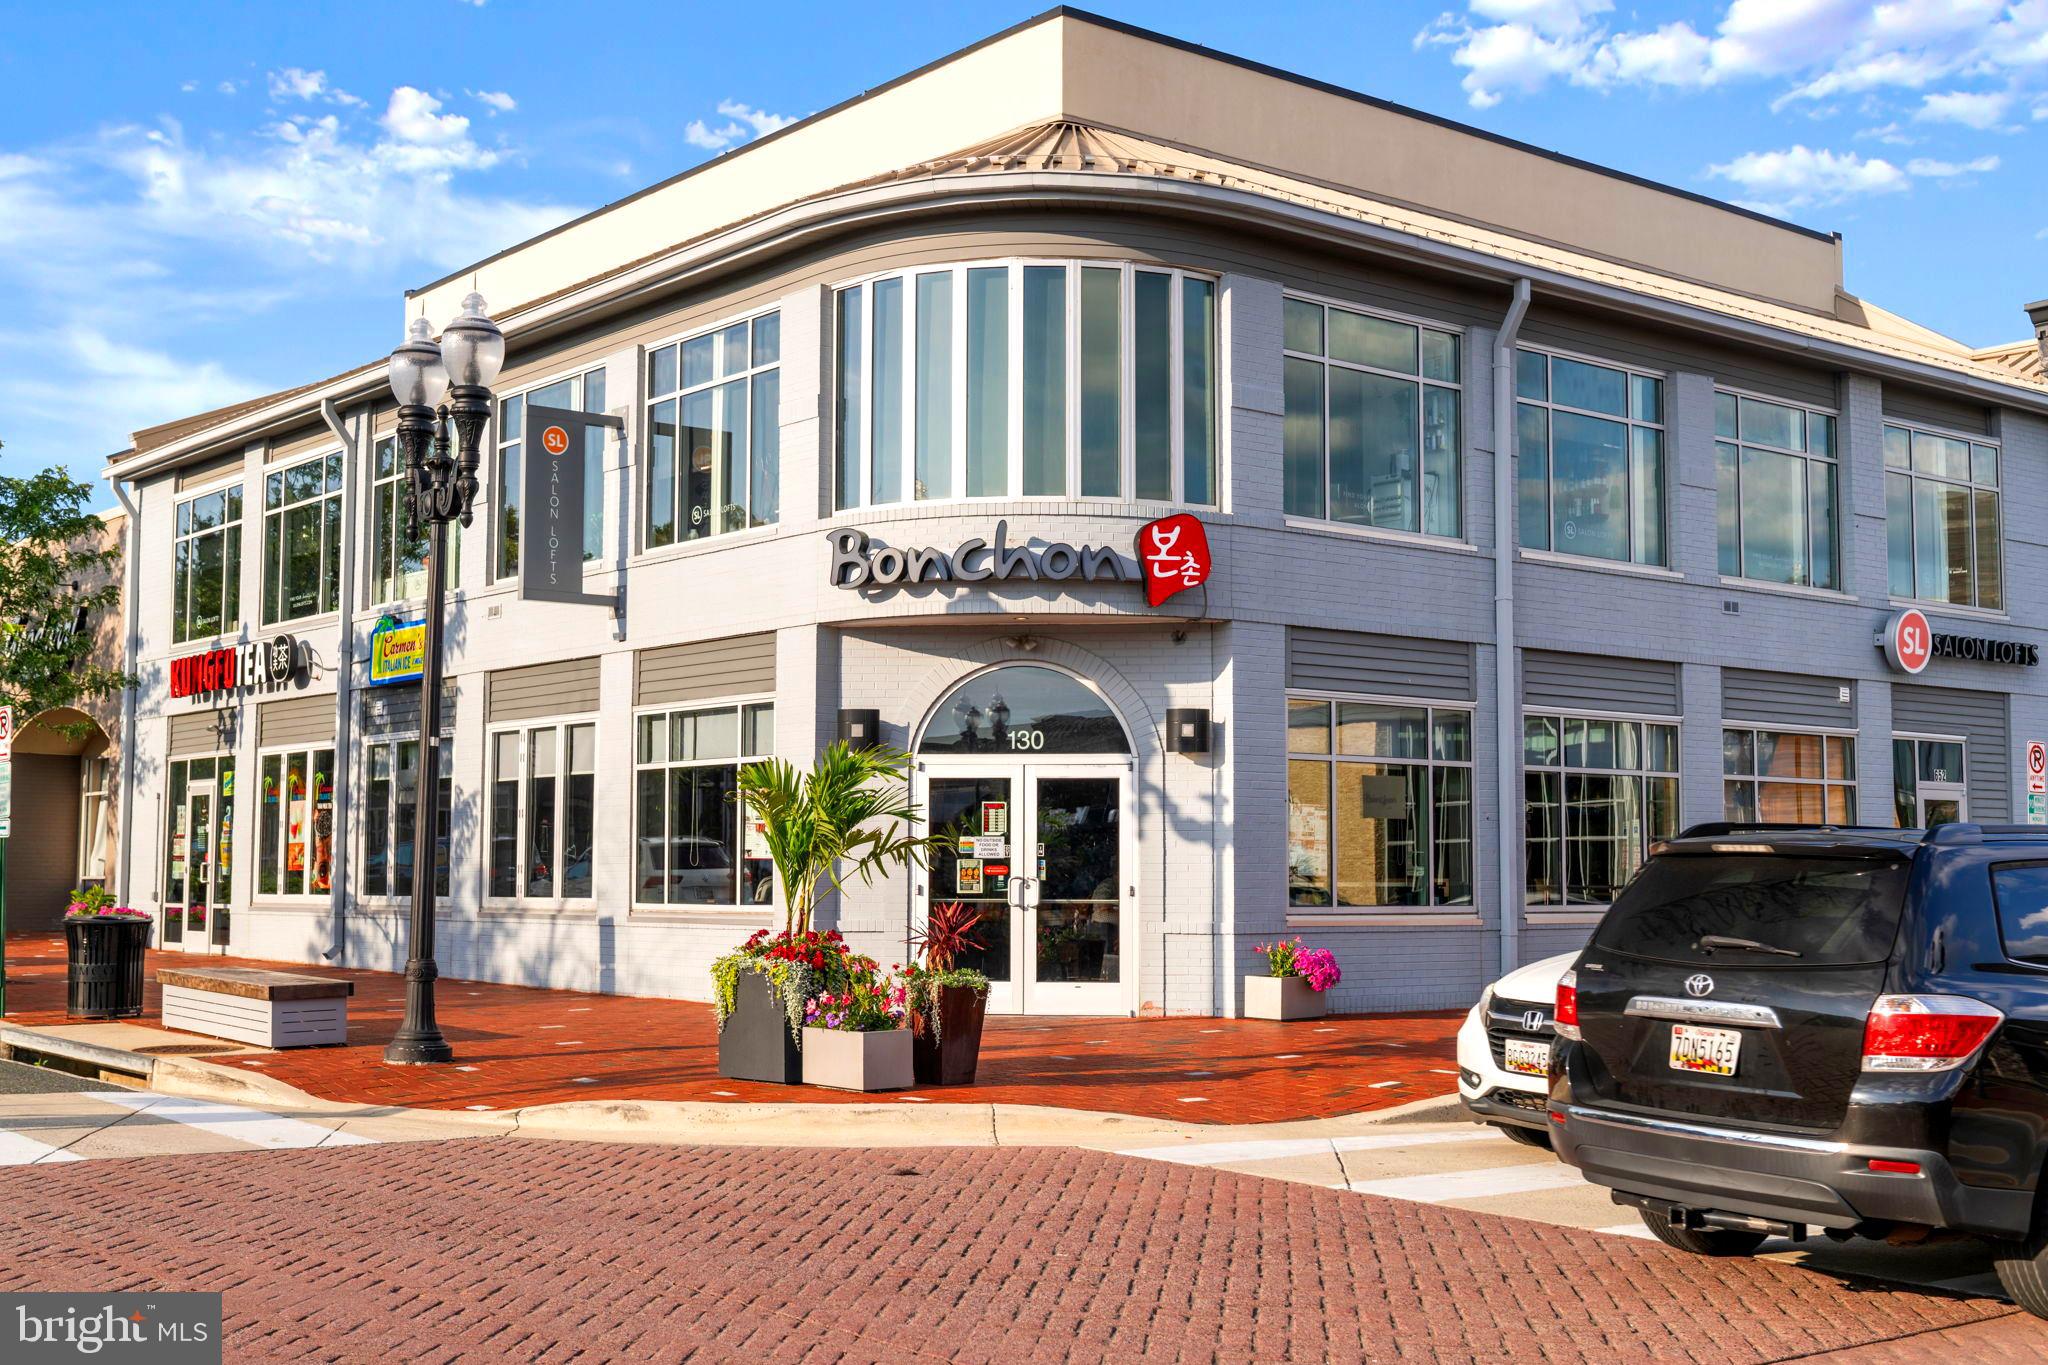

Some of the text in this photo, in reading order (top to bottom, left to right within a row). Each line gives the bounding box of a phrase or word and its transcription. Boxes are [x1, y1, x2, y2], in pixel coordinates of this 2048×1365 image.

[548, 434, 564, 448] SL
[549, 460, 560, 585] SALON LOFTS
[826, 519, 1126, 590] Bonchon
[1147, 525, 1200, 586] 본촌
[1903, 627, 1924, 656] SL
[1933, 633, 2040, 667] SALON LOFTS
[235, 642, 267, 687] TEA
[1007, 730, 1044, 750] 130
